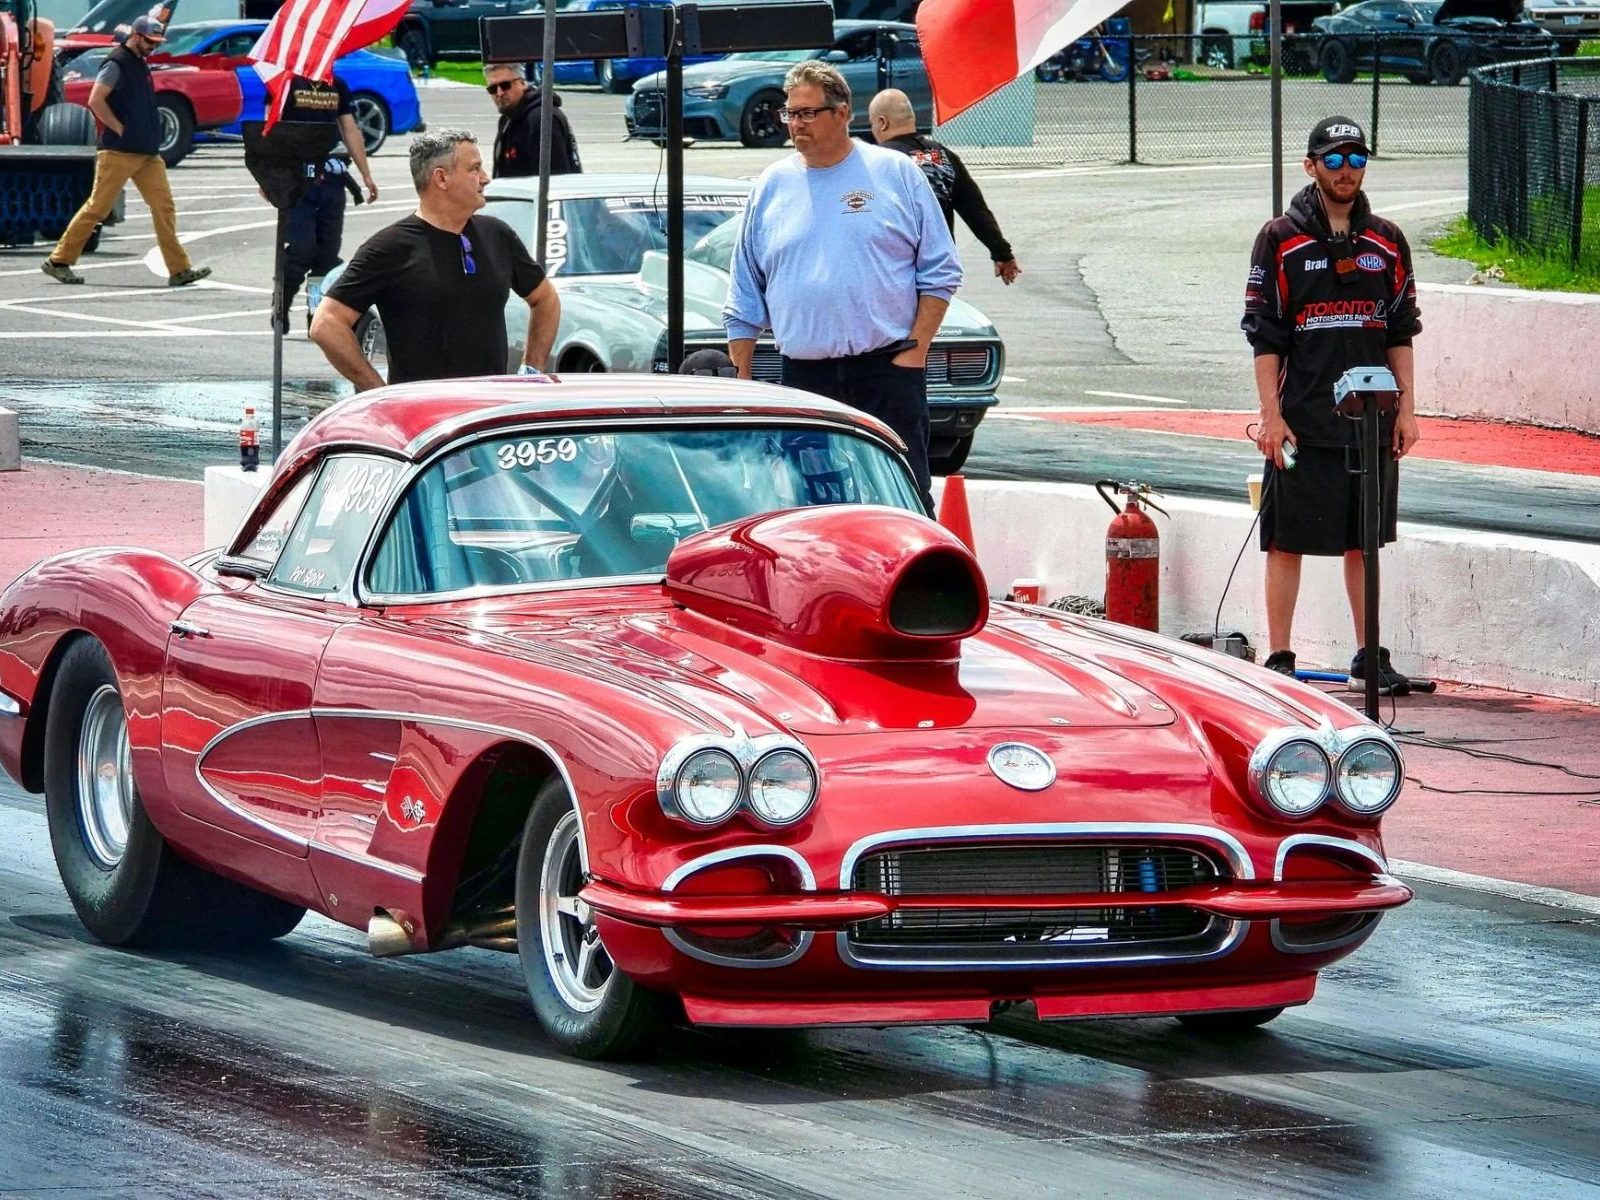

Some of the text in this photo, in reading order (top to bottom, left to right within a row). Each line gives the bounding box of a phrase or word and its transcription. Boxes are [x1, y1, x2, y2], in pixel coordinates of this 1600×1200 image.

[545, 200, 568, 278] 1967
[1304, 257, 1328, 271] Brad
[1359, 256, 1383, 268] NHRA
[1354, 313, 1372, 321] PARK
[498, 437, 577, 470] 3959
